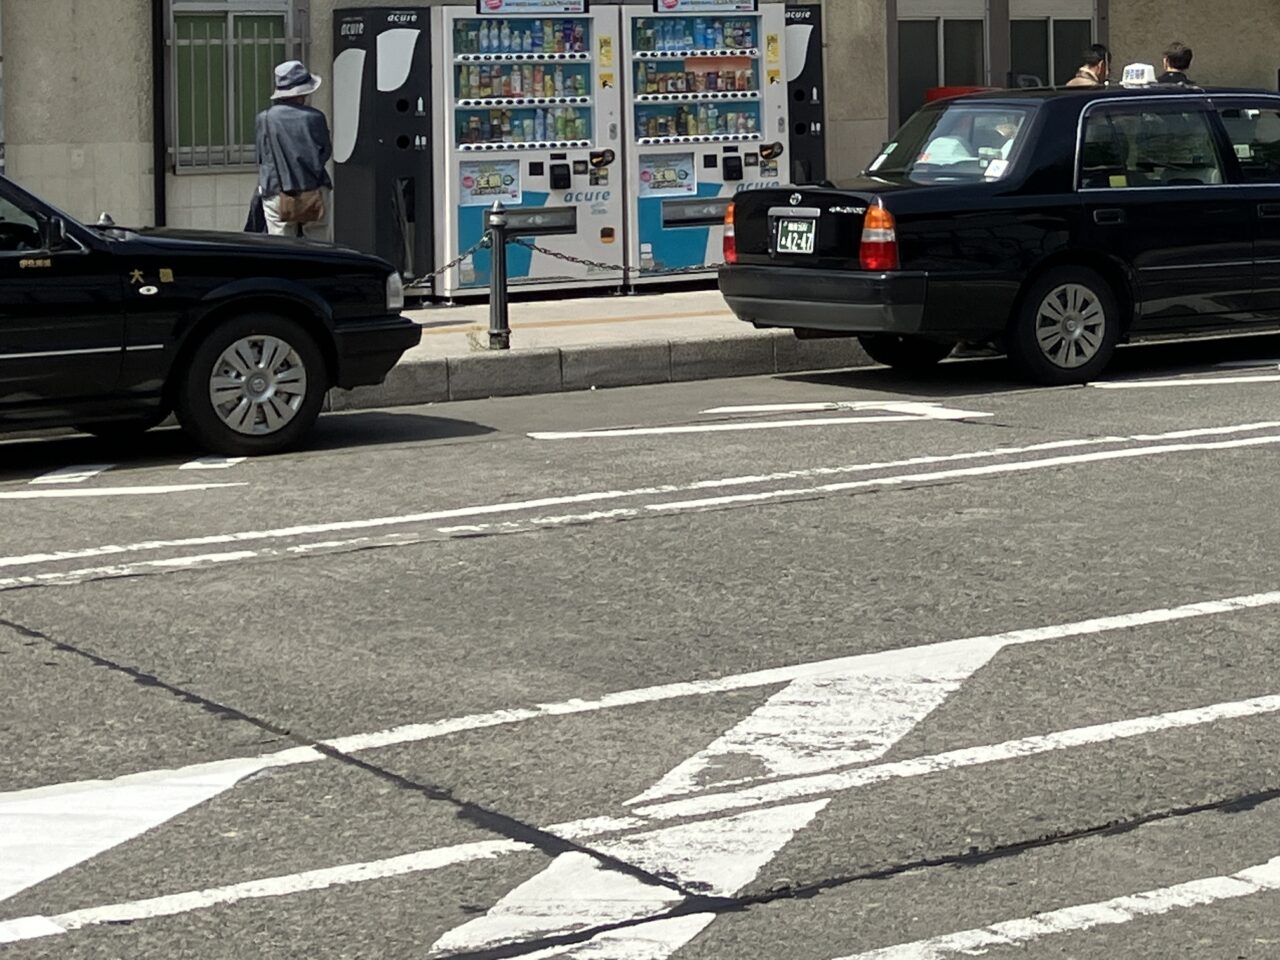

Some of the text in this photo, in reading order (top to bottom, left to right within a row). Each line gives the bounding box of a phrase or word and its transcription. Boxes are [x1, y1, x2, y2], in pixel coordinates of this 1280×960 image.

[387, 14, 417, 22] acure
[564, 191, 611, 202] acure
[786, 232, 812, 251] 42-47
